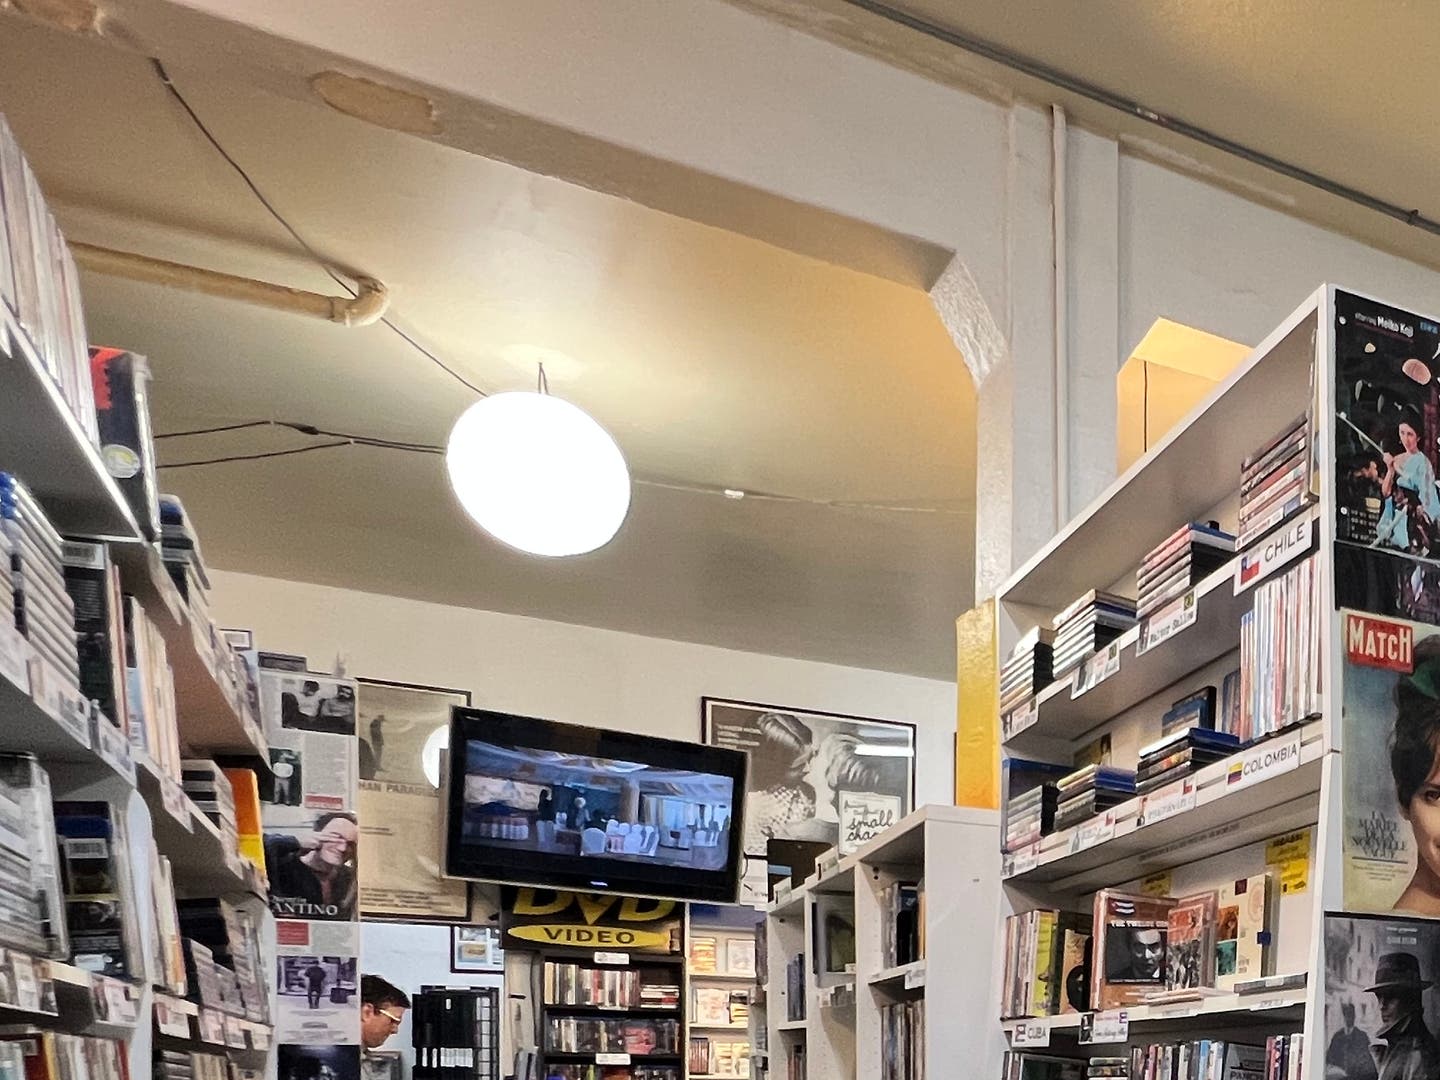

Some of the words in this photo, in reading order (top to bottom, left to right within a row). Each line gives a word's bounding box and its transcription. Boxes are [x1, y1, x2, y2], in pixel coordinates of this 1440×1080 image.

[1265, 521, 1305, 562] CHILE
[1350, 618, 1412, 664] MATCH
[1243, 745, 1297, 776] COLOMBIA
[849, 809, 893, 830] small
[274, 901, 338, 916] ANTINO
[512, 888, 677, 925] DVD
[544, 927, 635, 944] VIDEO
[1027, 1025, 1046, 1039] CUBA
